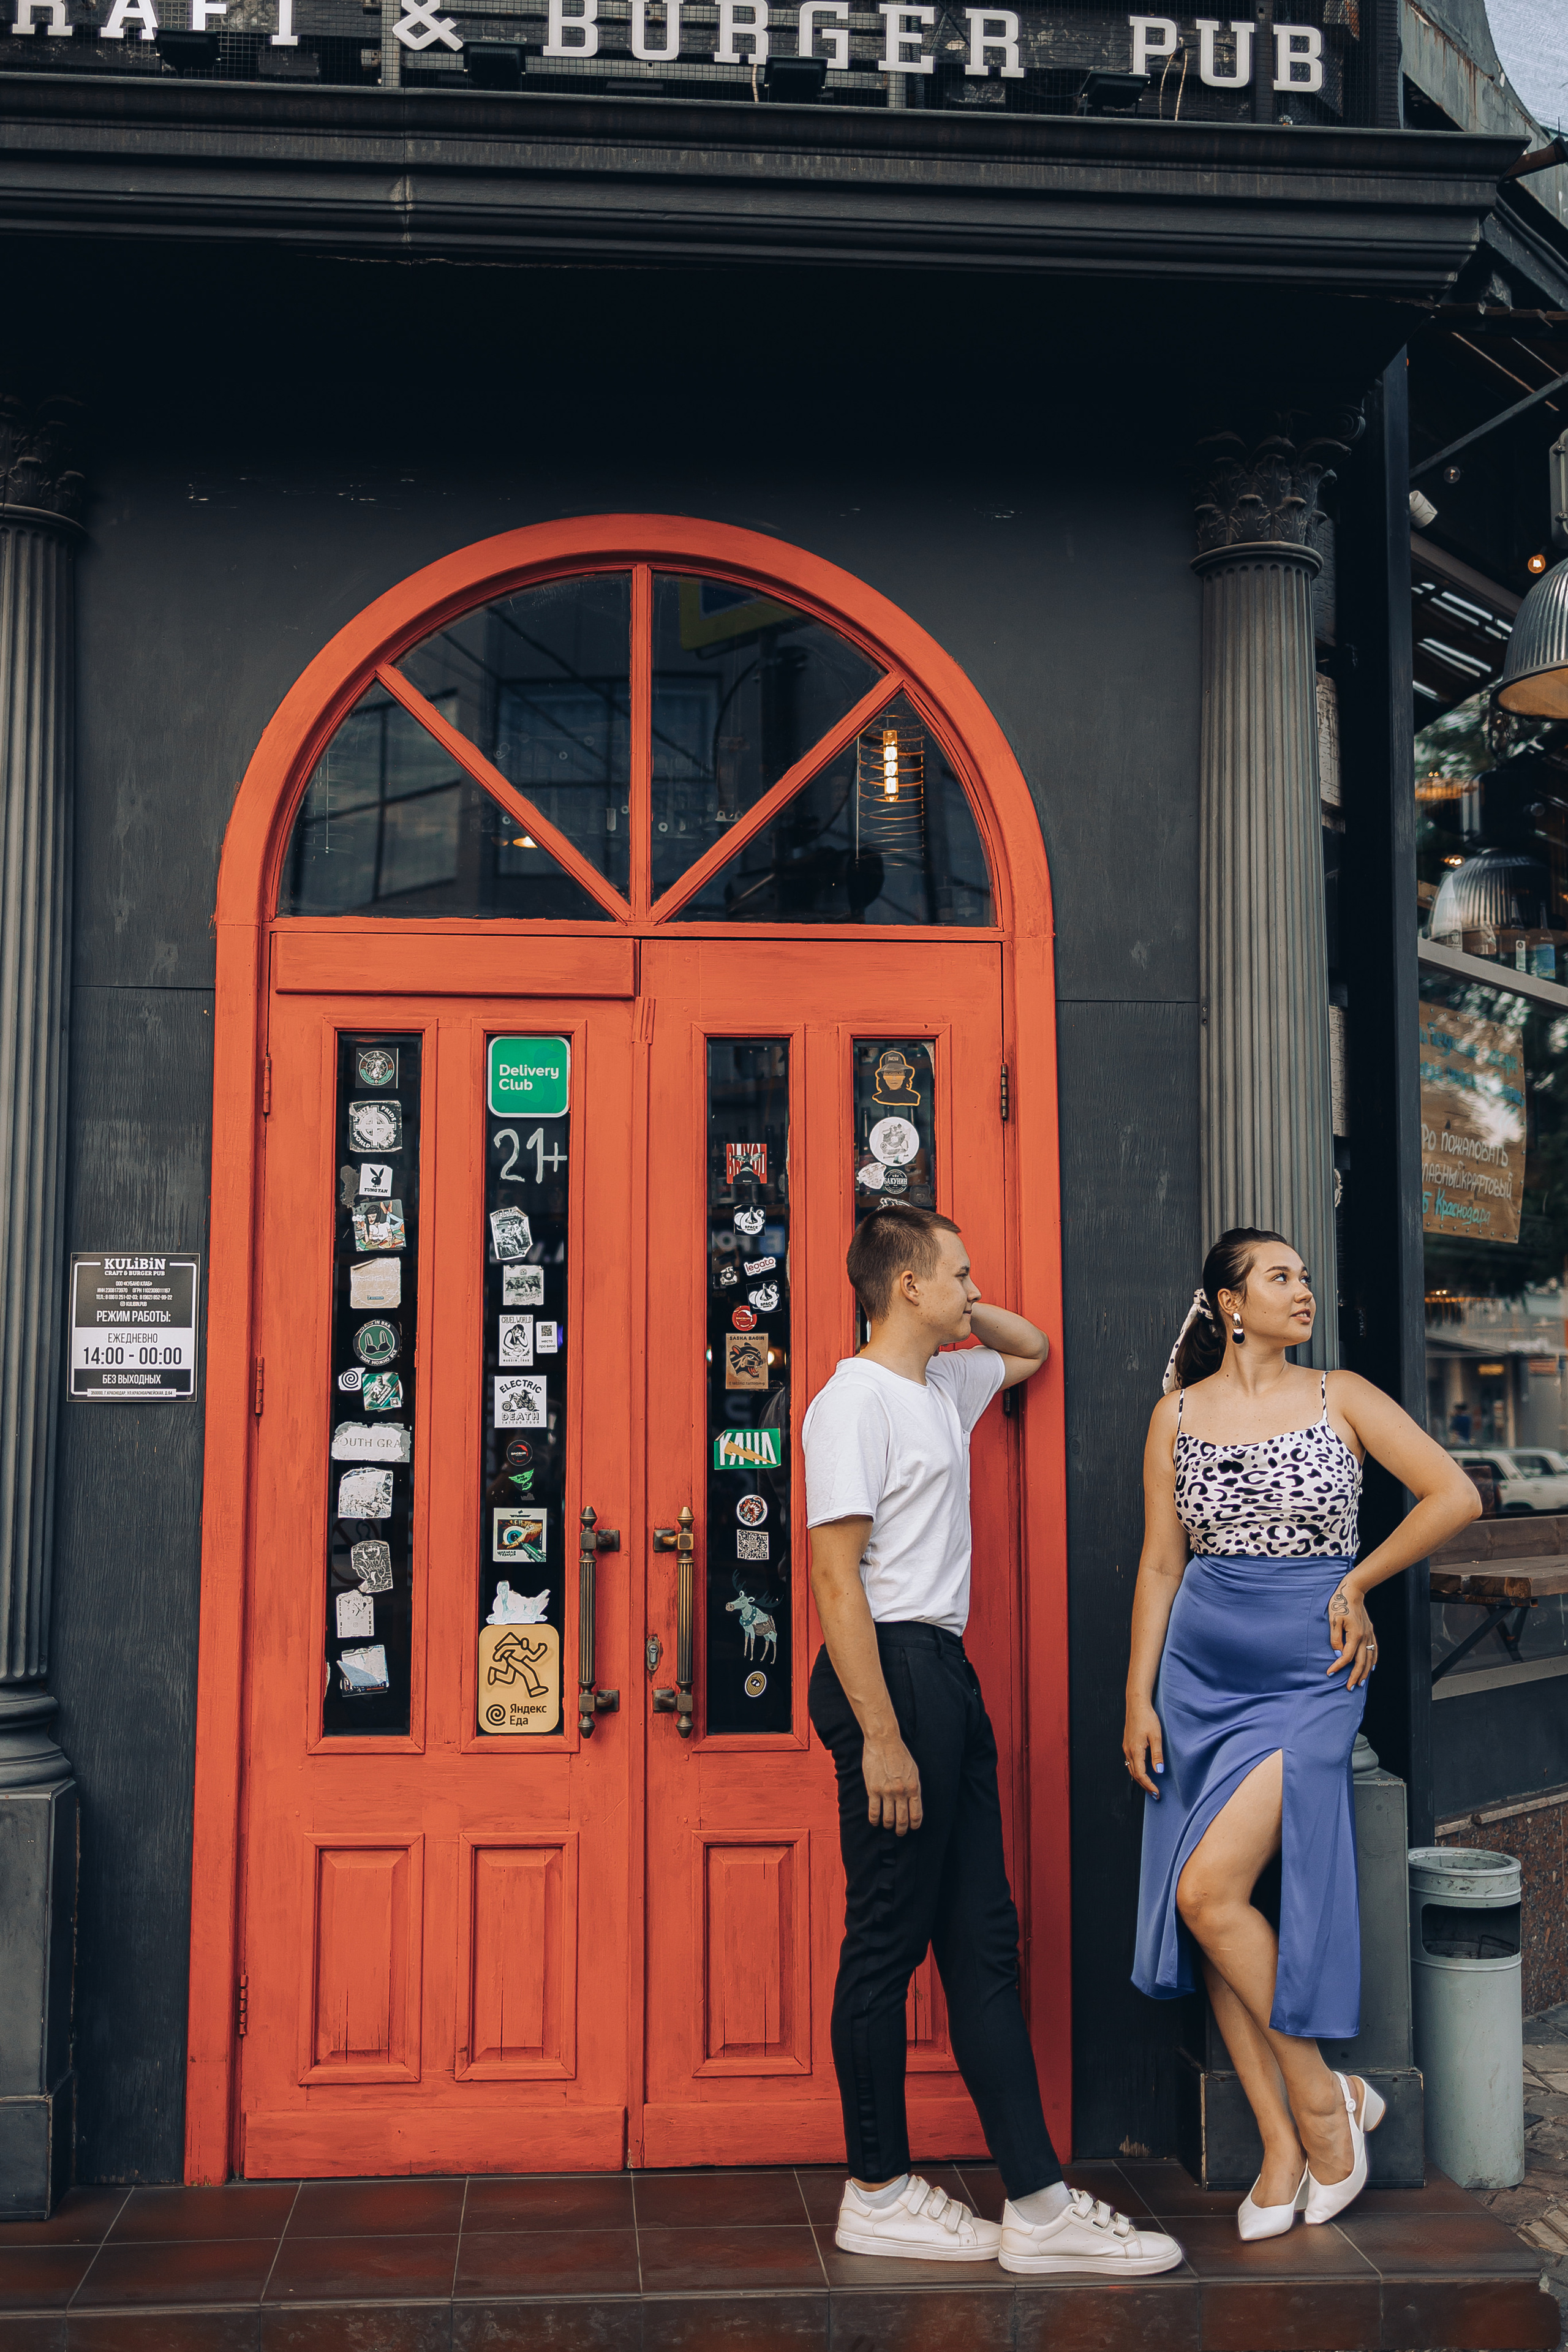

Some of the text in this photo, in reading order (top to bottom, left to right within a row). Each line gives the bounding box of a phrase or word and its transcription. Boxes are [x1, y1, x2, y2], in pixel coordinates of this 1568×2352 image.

[392, 0, 463, 51] &
[543, 0, 1024, 78] BURGER
[1129, 16, 1324, 93] PUB
[499, 1065, 559, 1079] Delivery
[499, 1079, 533, 1091] Club
[381, 1106, 396, 1121] PRIDE
[353, 1131, 371, 1148] WORLD
[493, 1128, 568, 1184] 21+
[745, 1259, 774, 1272] legato
[96, 1310, 172, 1322] РЕЖИМ РАБОТЫ:
[108, 1333, 158, 1344] ЕЖЕДНЕВНО
[83, 1347, 124, 1365] 14:00
[139, 1347, 182, 1365] 00:00
[360, 1355, 370, 1363] НАМ
[102, 1374, 161, 1385] БЕЗ ВЫХОДНЫХ
[499, 1379, 541, 1393] ELECTRIC
[510, 1703, 547, 1714] Яндекс
[510, 1715, 529, 1726] Еда
